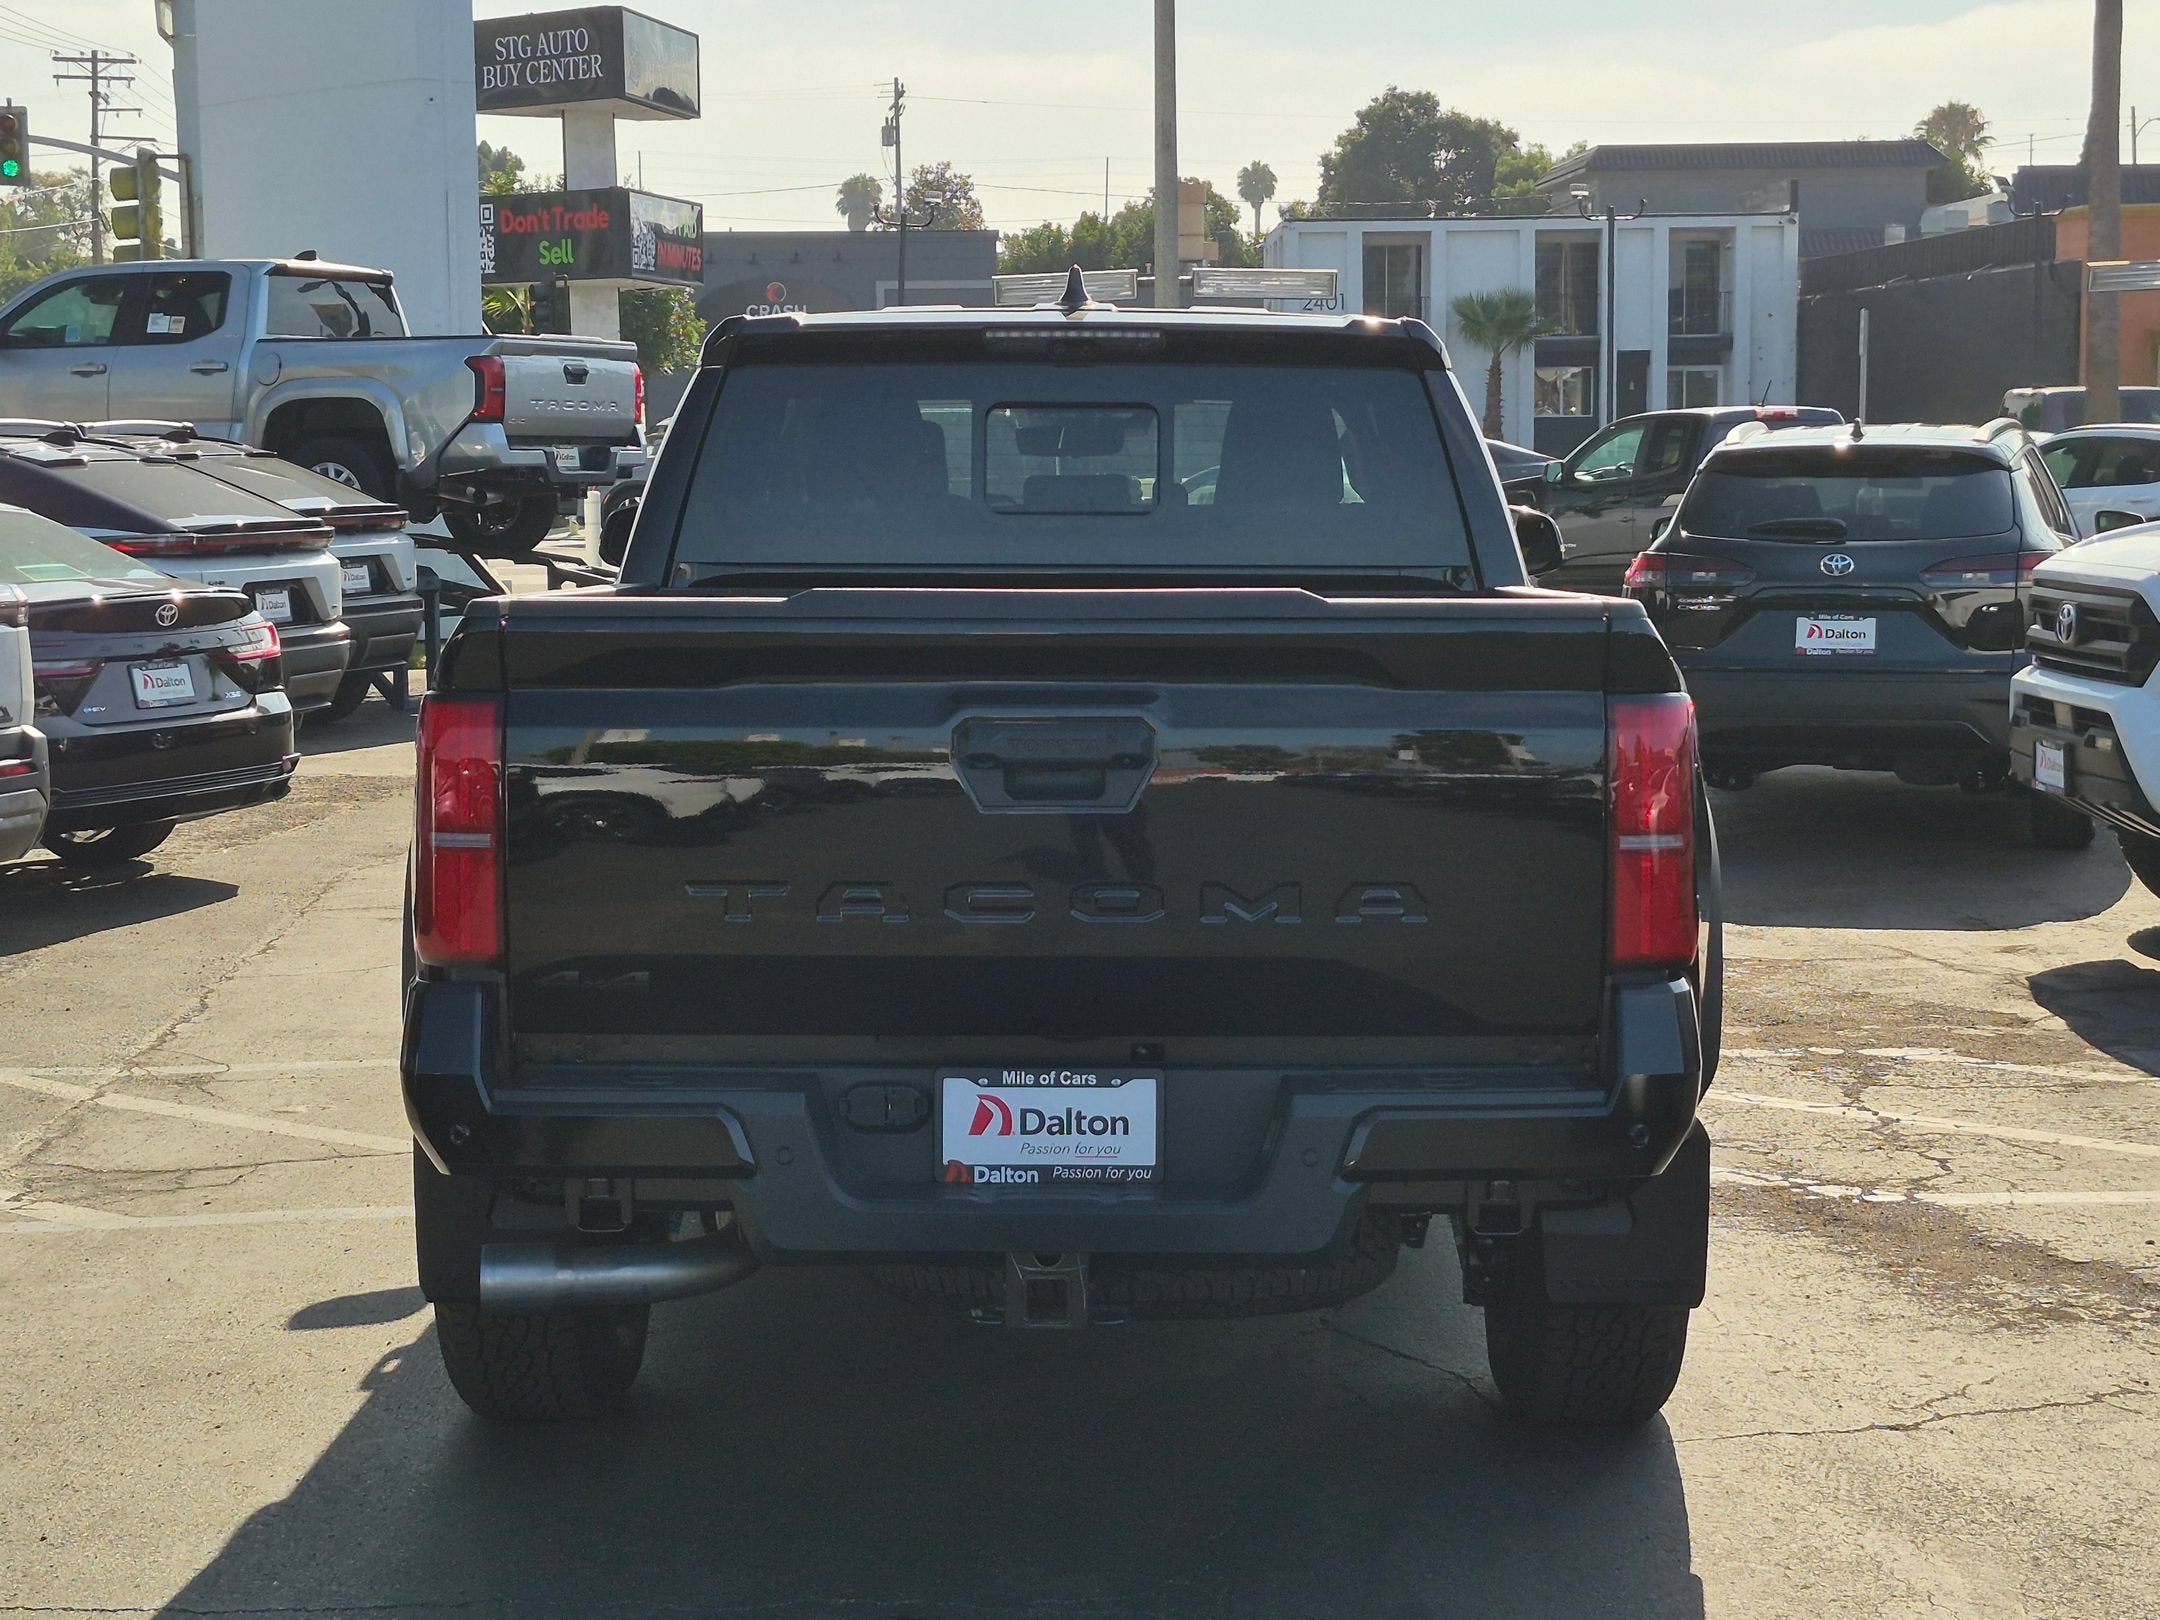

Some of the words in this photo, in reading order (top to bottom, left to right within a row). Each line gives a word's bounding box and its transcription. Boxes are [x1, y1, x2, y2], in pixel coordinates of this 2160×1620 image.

[495, 34, 532, 61] STG
[536, 27, 589, 57] AUTO
[483, 62, 522, 89] BUY
[526, 54, 604, 84] CENTER
[500, 206, 550, 234] Don't
[551, 202, 609, 231] Trade
[539, 238, 575, 265] Sell
[746, 304, 807, 317] CRASH
[1302, 292, 1345, 311] 2401
[530, 399, 618, 412] TACOMA
[1825, 628, 1866, 639] Dalton
[156, 676, 186, 689] Dalton
[684, 880, 1429, 923] TACOMA
[1002, 1070, 1034, 1085] Mile
[1039, 1070, 1055, 1085] of
[1060, 1070, 1097, 1085] Cars
[1019, 1107, 1130, 1136] Dalton
[1020, 1142, 1071, 1155] Passion
[1074, 1142, 1095, 1156] for
[1096, 1145, 1122, 1157] you
[973, 1165, 1039, 1184] Dalton
[1052, 1166, 1101, 1179] Passion
[1105, 1166, 1125, 1180] for
[1126, 1168, 1152, 1181] you
